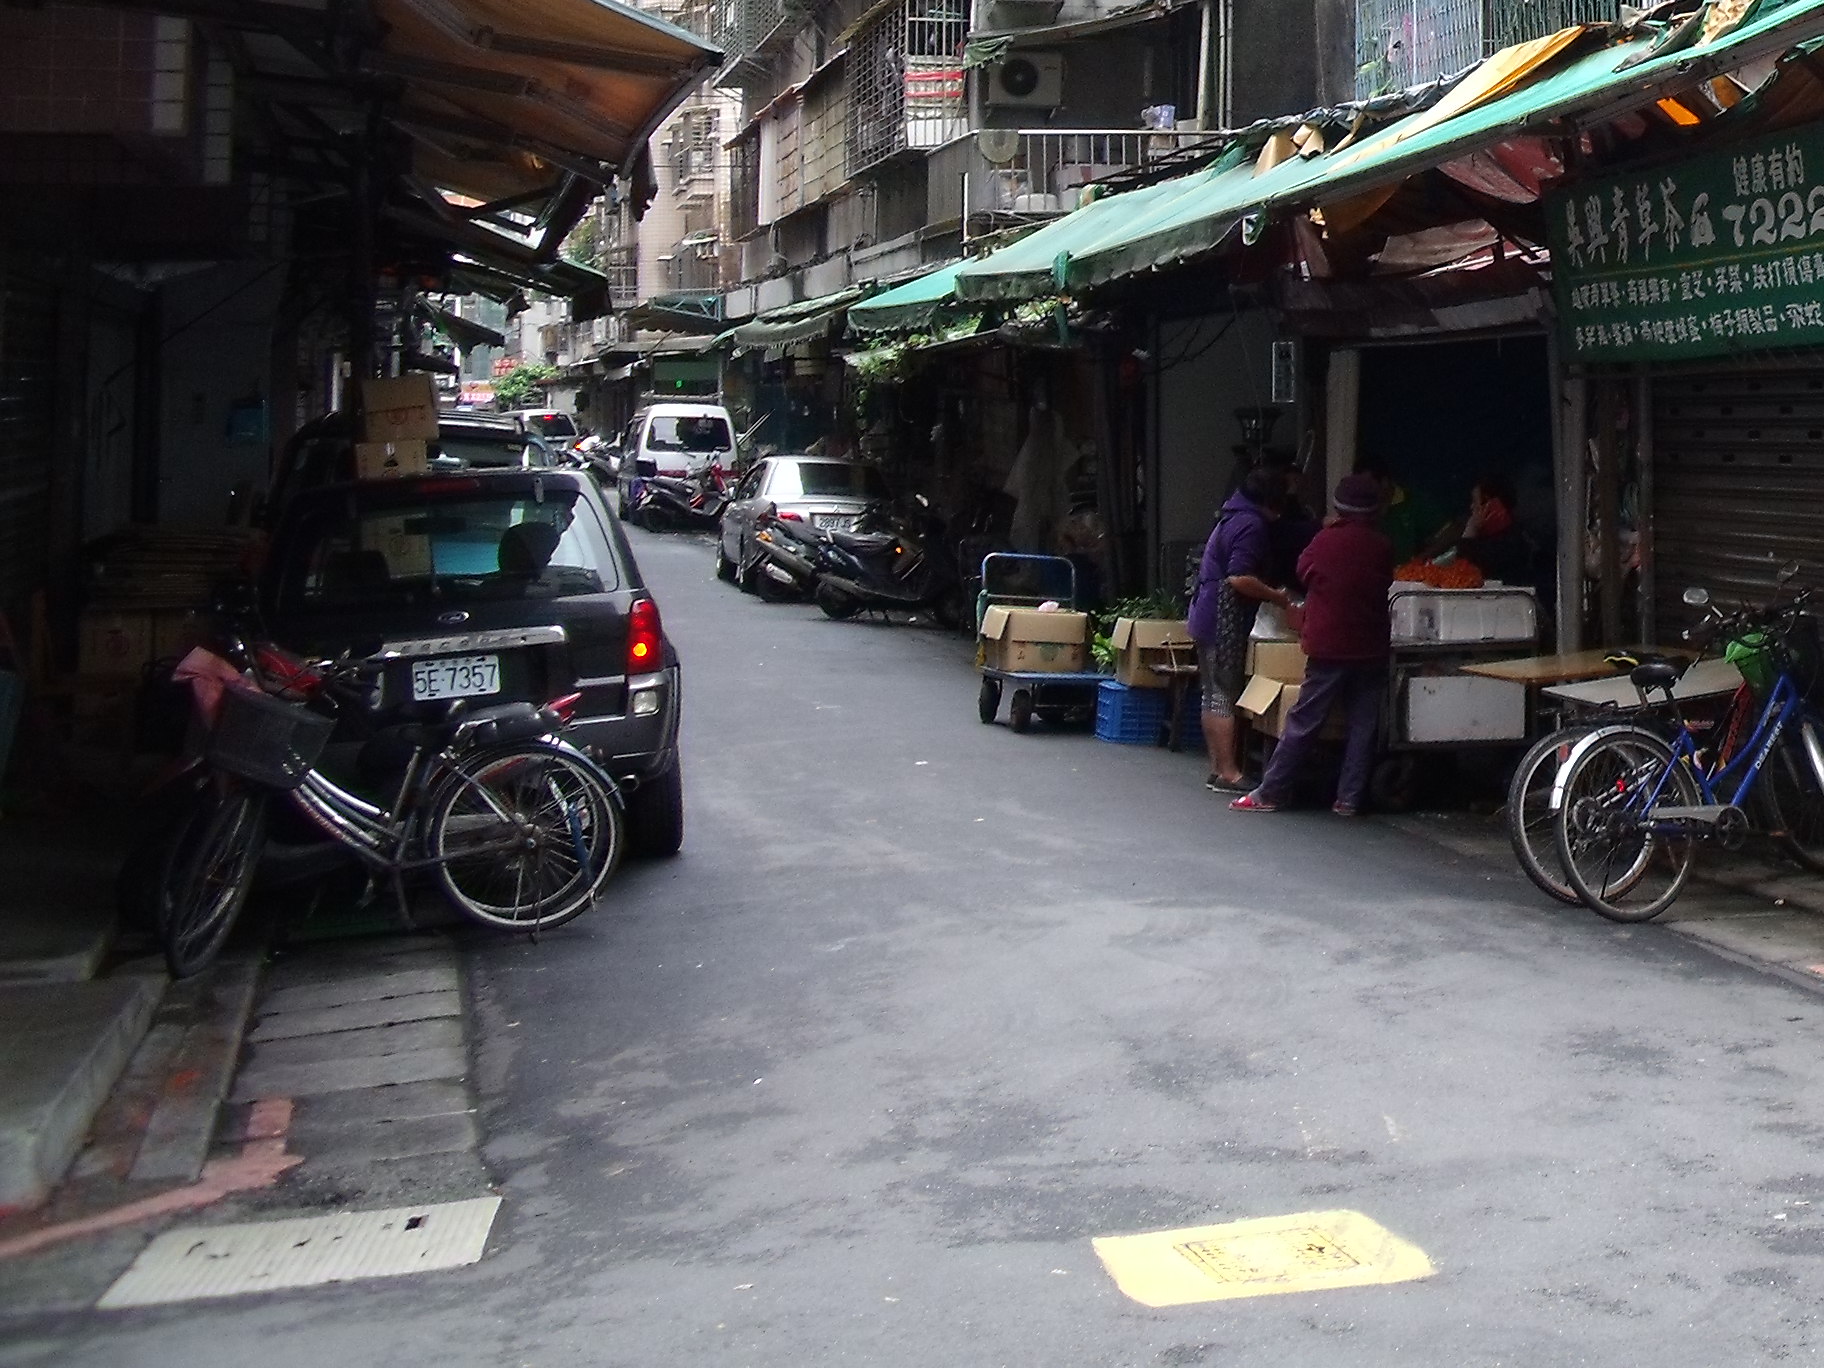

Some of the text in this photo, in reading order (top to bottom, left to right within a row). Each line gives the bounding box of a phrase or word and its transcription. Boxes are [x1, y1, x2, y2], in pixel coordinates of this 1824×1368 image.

[1733, 141, 1805, 197] 健康有約
[414, 663, 498, 694] 5E-7357
